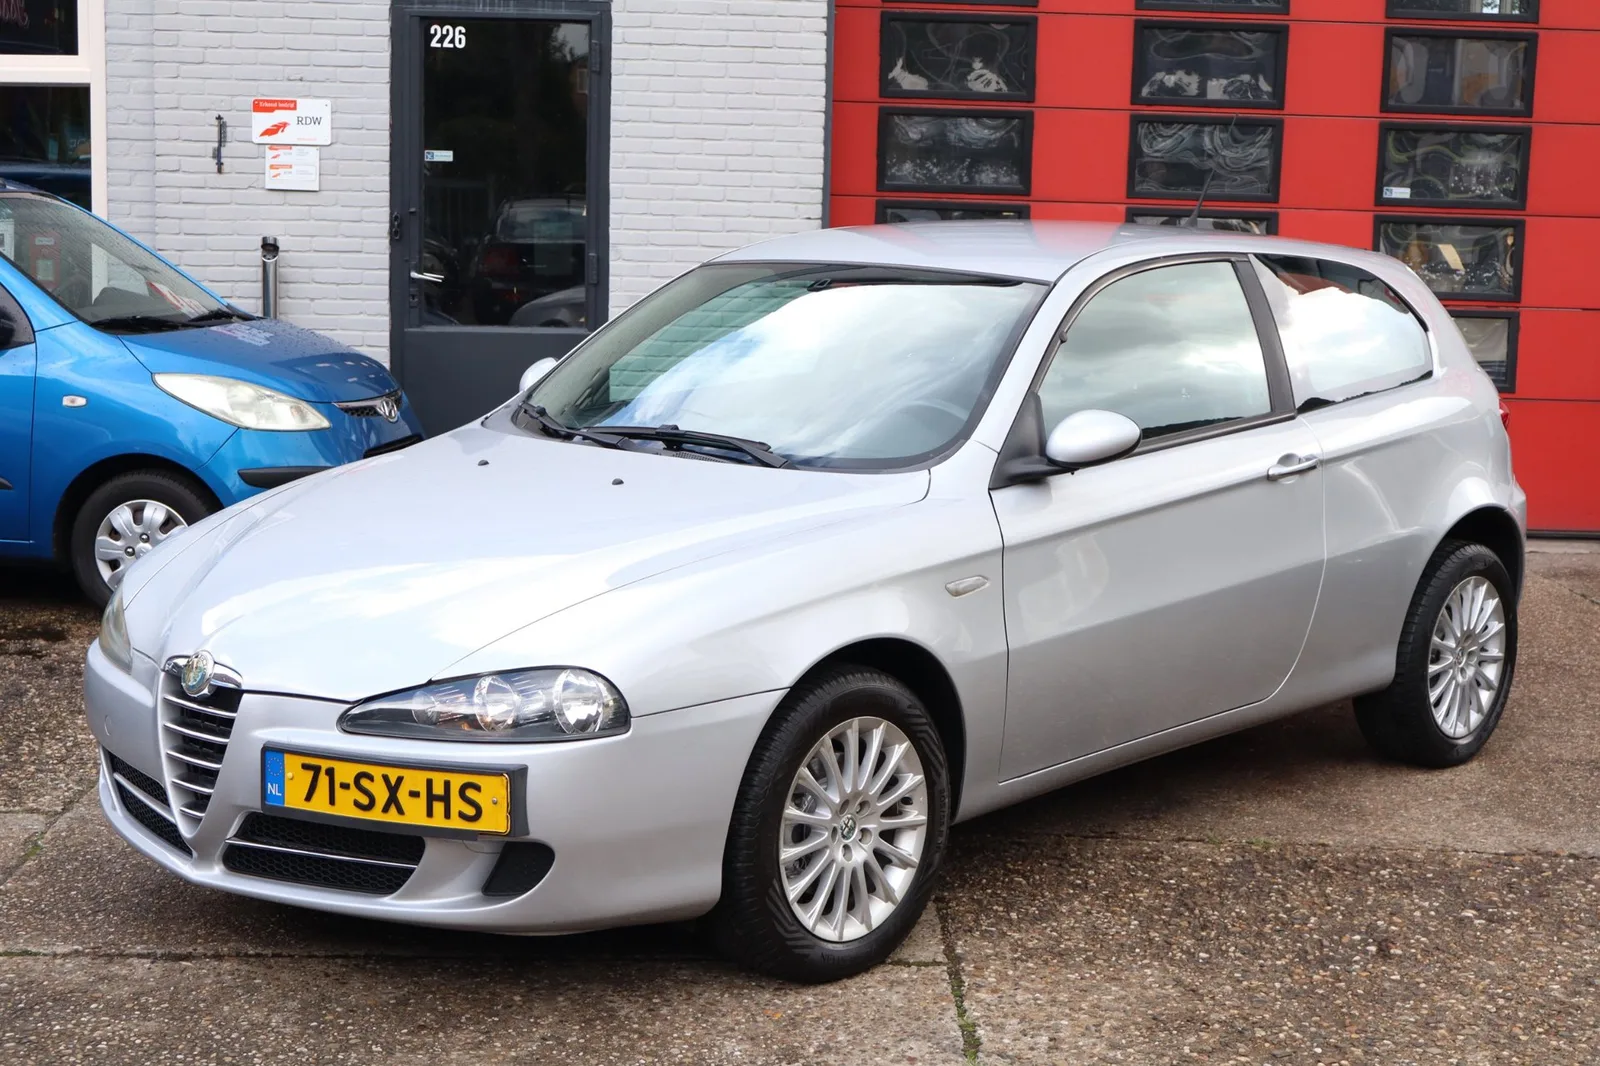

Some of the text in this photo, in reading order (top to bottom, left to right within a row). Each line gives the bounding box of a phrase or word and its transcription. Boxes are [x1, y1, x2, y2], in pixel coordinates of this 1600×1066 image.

[429, 24, 467, 49] 226
[296, 115, 323, 126] RDW
[267, 782, 282, 796] NL
[301, 762, 483, 822] 71-SX-HS
